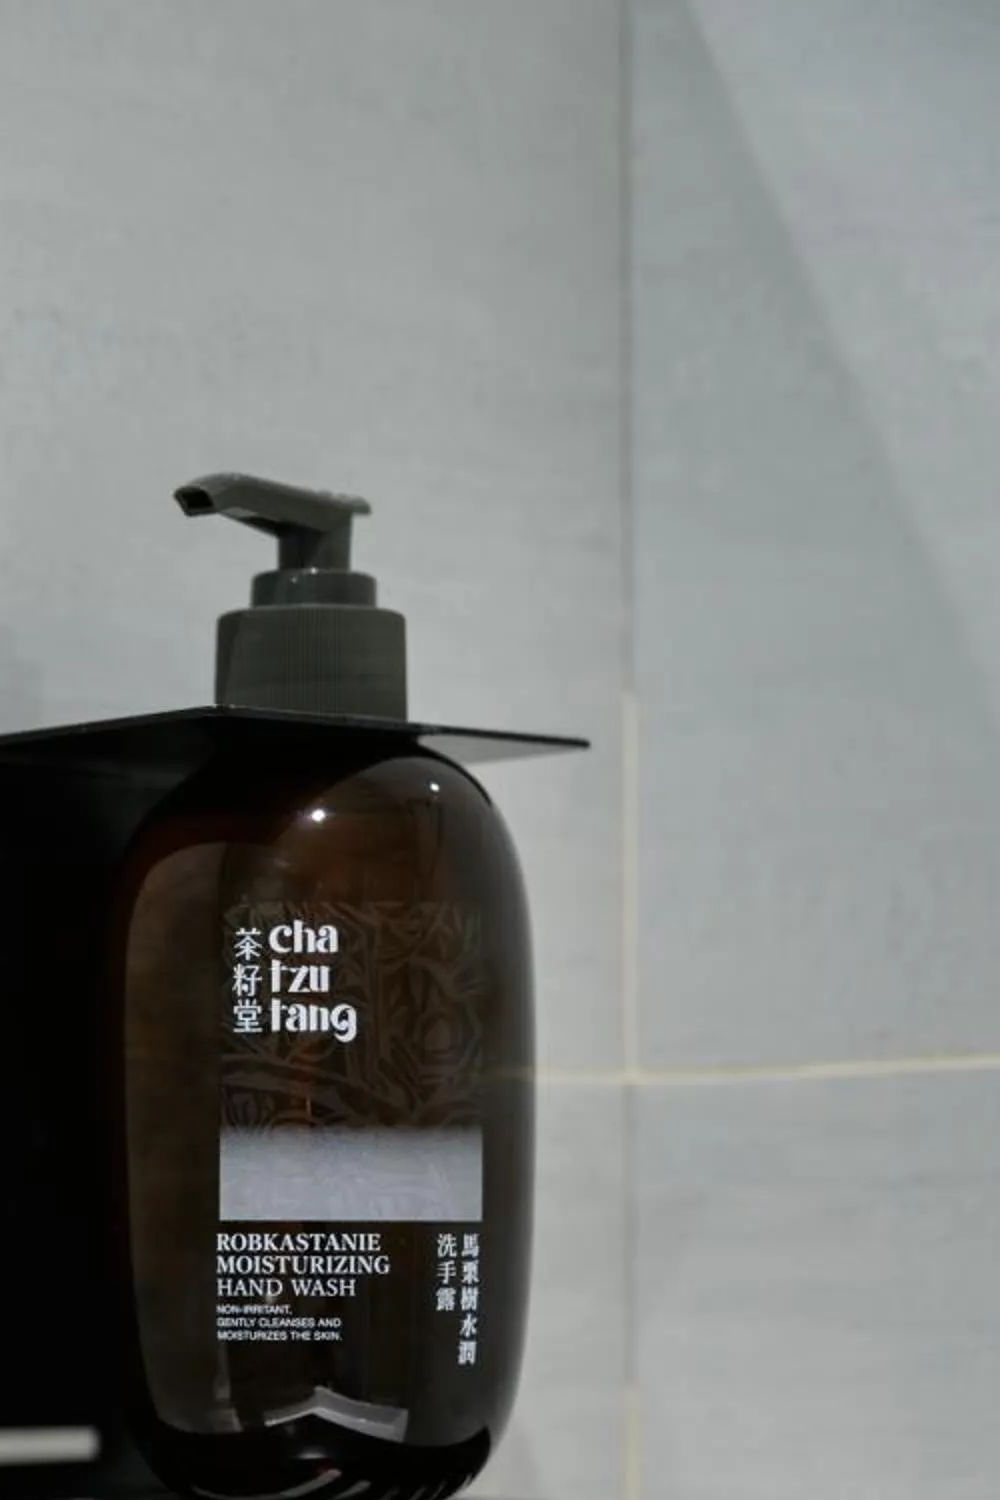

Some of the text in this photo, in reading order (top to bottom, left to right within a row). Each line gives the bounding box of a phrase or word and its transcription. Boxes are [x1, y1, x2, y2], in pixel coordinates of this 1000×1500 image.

[268, 919, 339, 953] cha
[232, 927, 263, 1033] 茶籽堂
[269, 959, 330, 993] tzu
[269, 998, 357, 1042] tang
[216, 1233, 381, 1252] ROBKASTANIE
[216, 1255, 391, 1275] MOISTURIZING
[217, 1278, 356, 1297] HAND WASH
[216, 1317, 342, 1328] GENTLY CLEANSES AND
[216, 1330, 343, 1341] MOISTURIZES THE SKIN.
